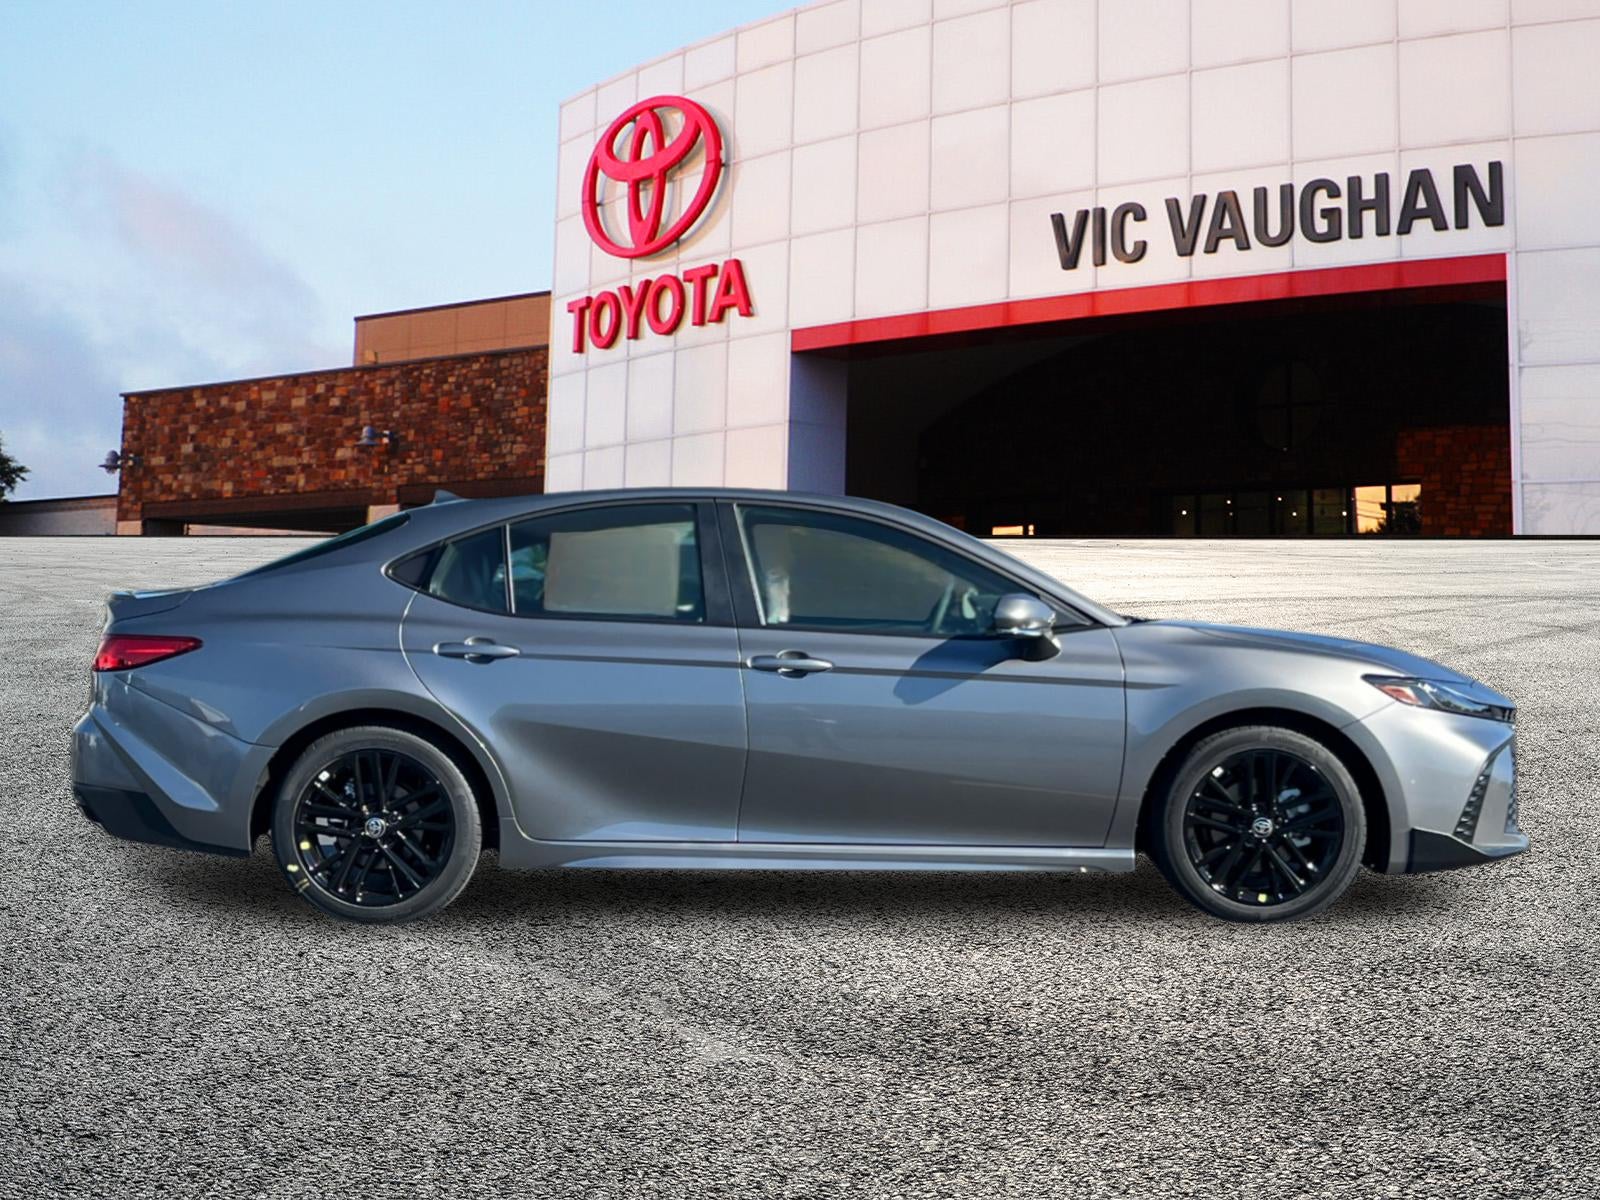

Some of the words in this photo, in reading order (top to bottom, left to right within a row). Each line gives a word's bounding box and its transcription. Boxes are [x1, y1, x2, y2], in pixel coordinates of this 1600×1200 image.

[1050, 201, 1148, 271] VIC
[1165, 160, 1505, 257] VAUGHAN
[567, 258, 754, 354] TOYOTA
